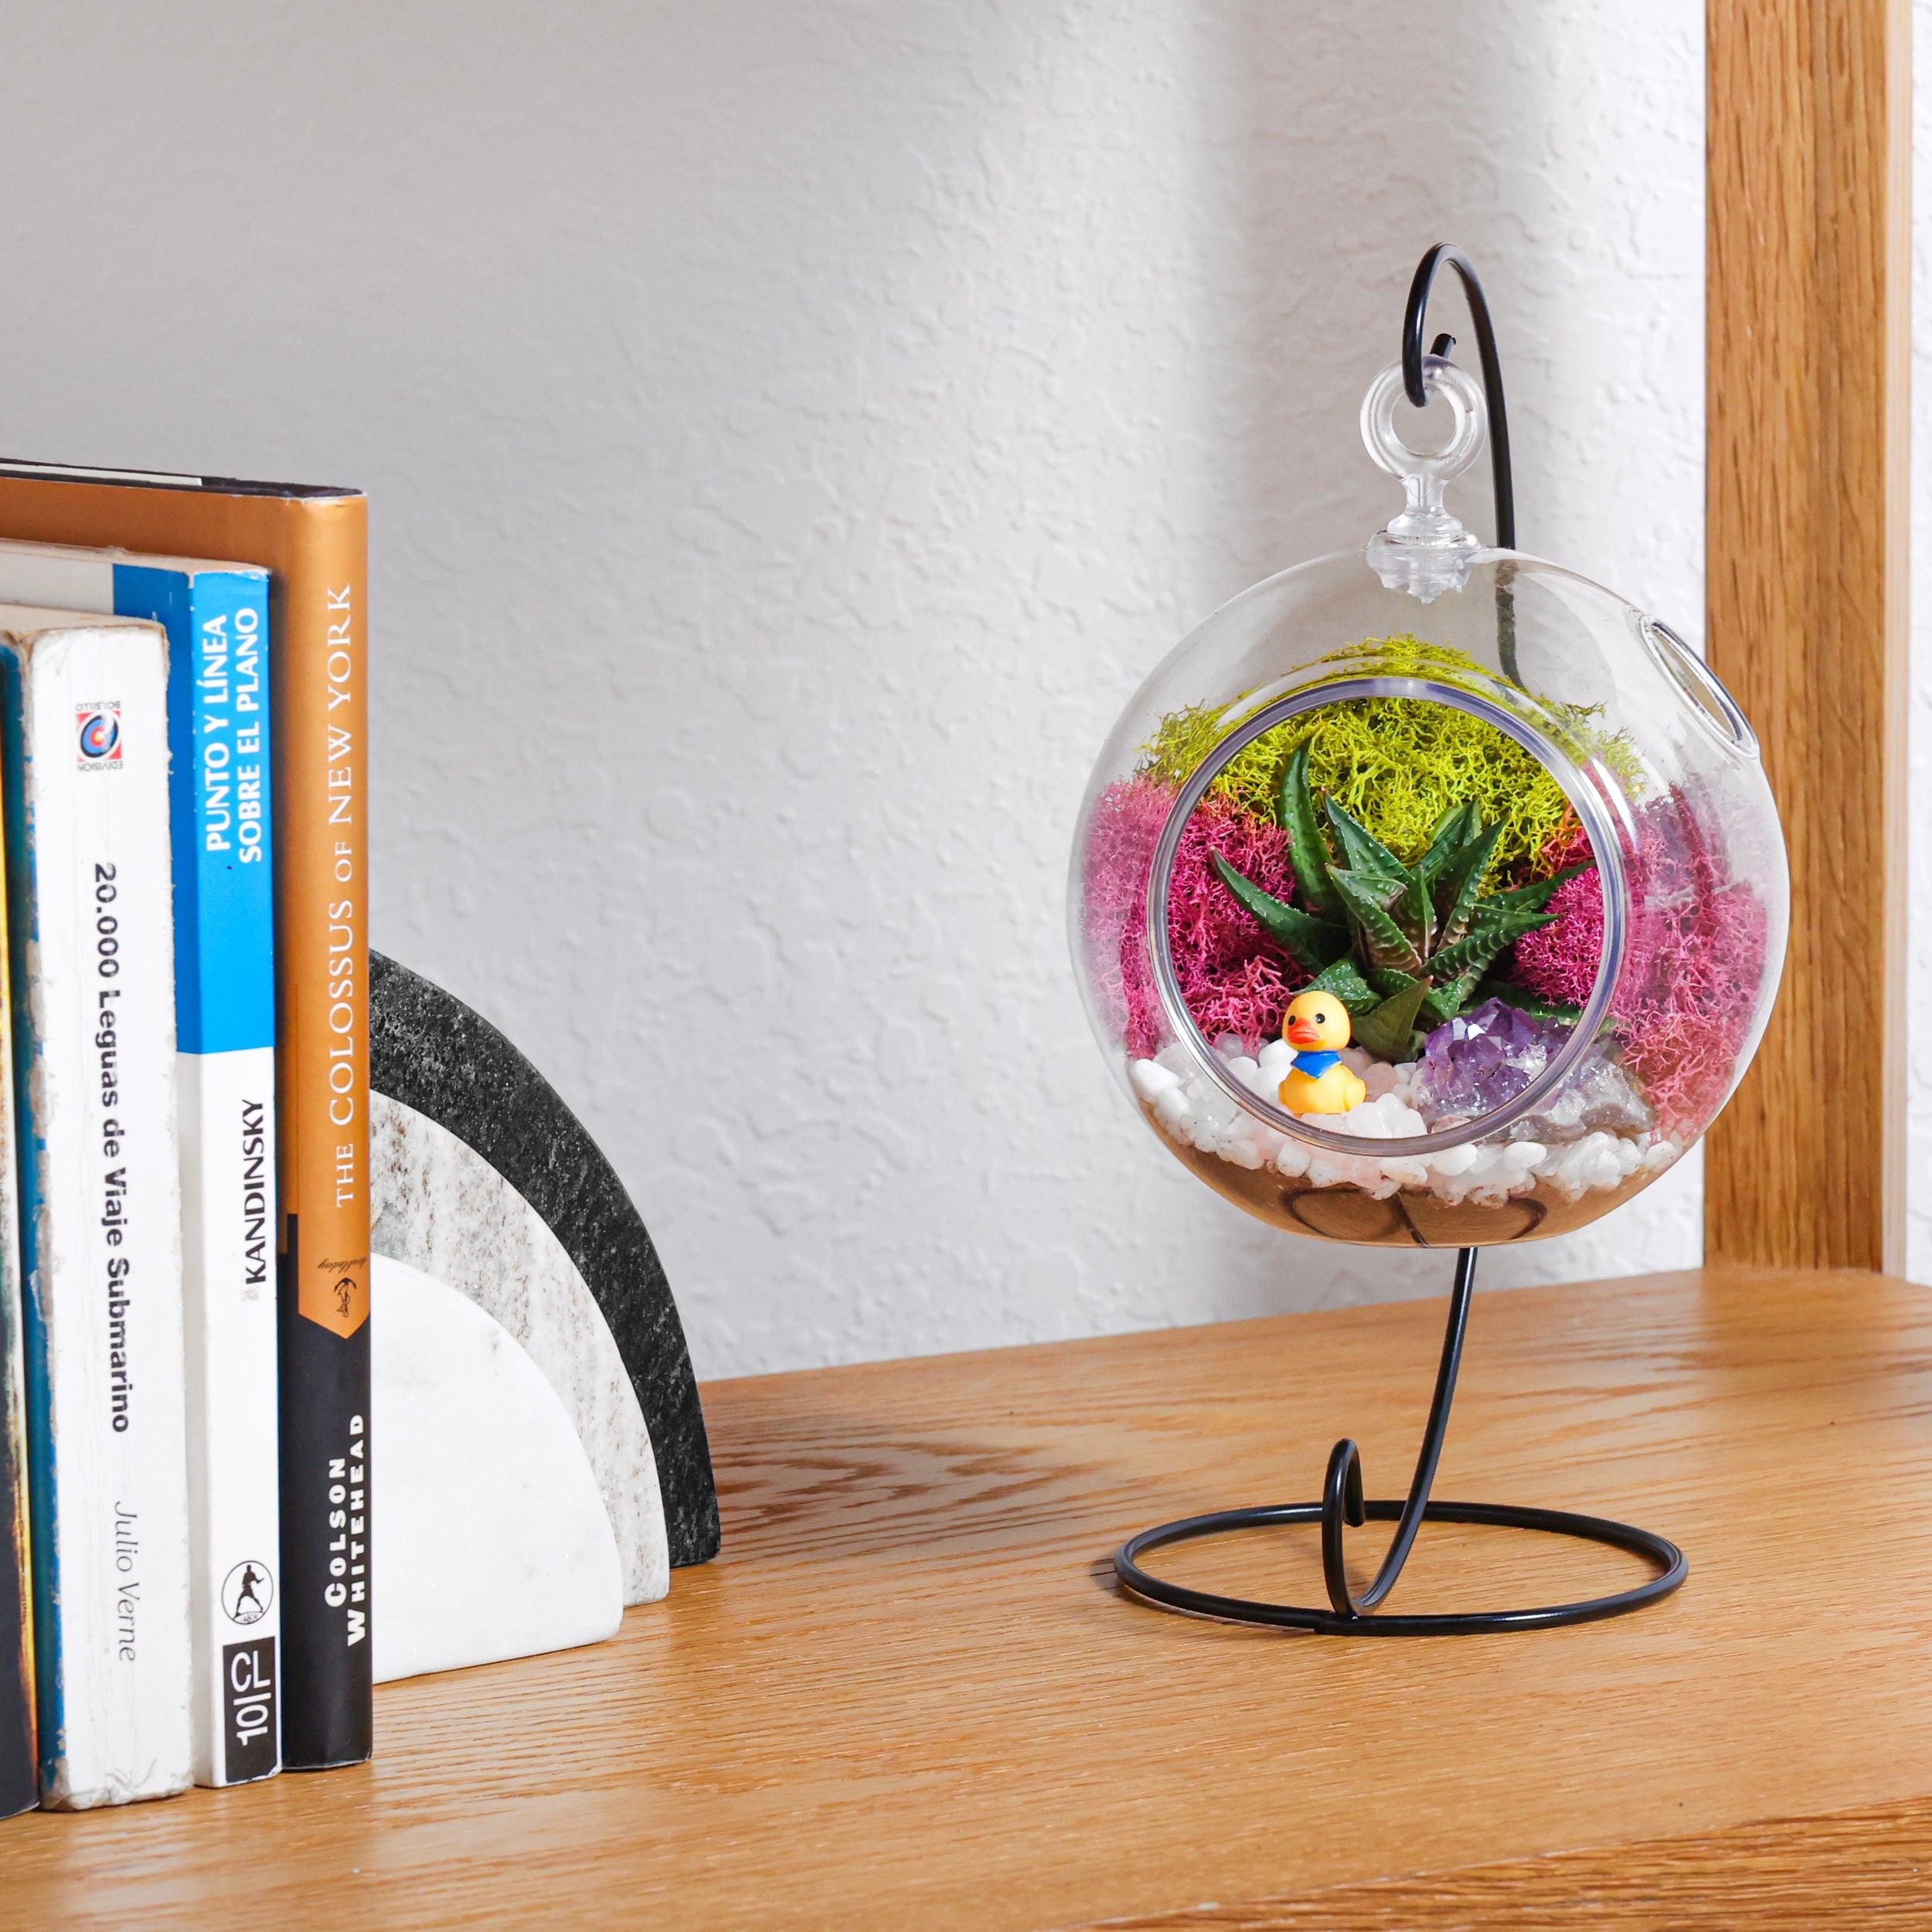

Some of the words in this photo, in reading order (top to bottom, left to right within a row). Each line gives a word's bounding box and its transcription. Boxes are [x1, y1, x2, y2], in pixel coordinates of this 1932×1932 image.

[197, 615, 228, 703] LÍNEA
[235, 608, 259, 711] PLANO
[327, 583, 351, 711] YORK
[204, 715, 229, 733] Y
[237, 722, 260, 753] EL
[328, 724, 351, 825] NEW
[204, 743, 230, 851] PUNTO
[237, 765, 262, 863] SOBRE
[335, 842, 352, 882] OF
[96, 864, 118, 978] 20.000
[96, 991, 120, 1107] Leguas
[328, 900, 353, 1125] COLOSSUS
[104, 1119, 124, 1157] de
[336, 1144, 353, 1207] THE
[102, 1168, 127, 1246] Viaje
[243, 1100, 266, 1284] KANDINSKY
[108, 1259, 132, 1432] Submarino
[115, 1502, 138, 1572] Julio
[325, 1459, 346, 1607] COLSON
[345, 1416, 365, 1646] WHITEHEAD
[118, 1583, 139, 1661] Verne
